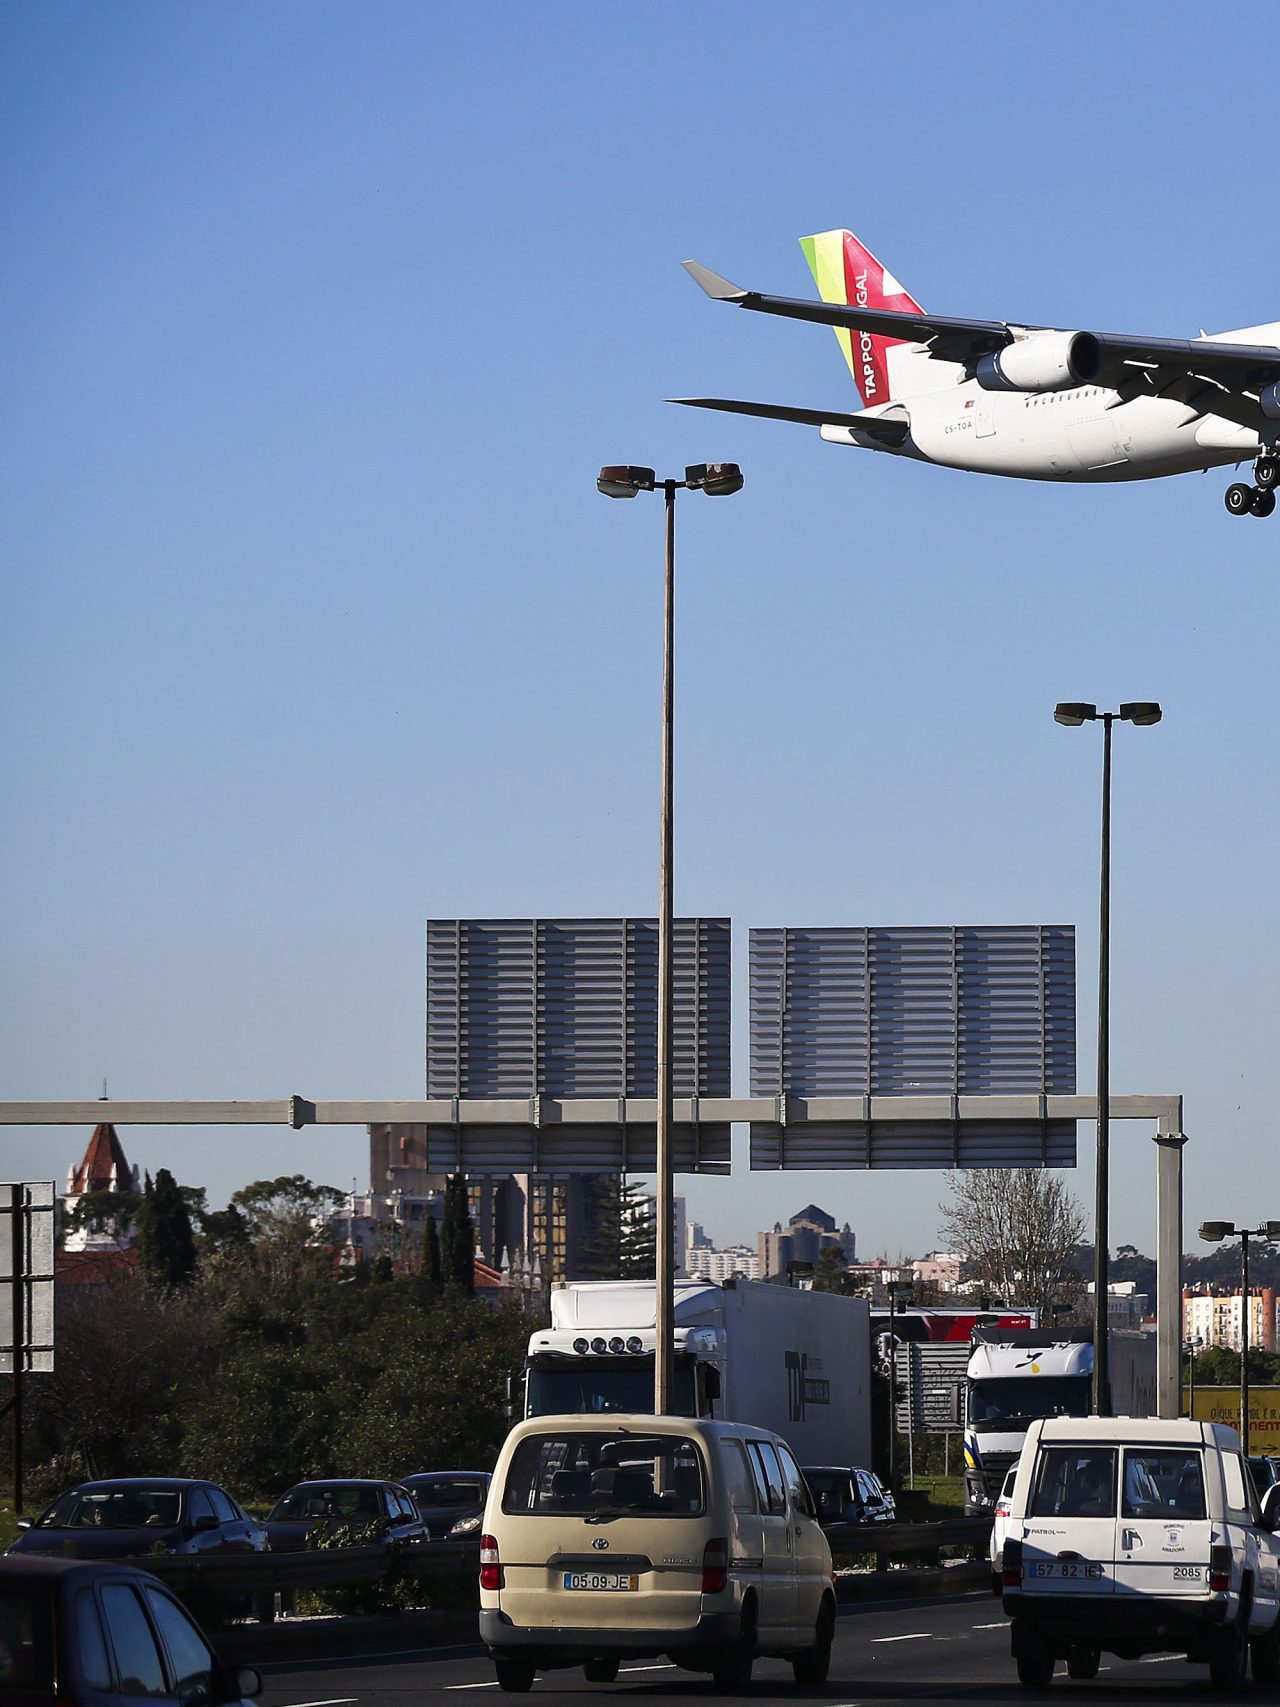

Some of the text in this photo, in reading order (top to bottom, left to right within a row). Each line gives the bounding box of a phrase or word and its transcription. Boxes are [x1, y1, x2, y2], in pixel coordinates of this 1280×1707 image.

[856, 269, 877, 399] TAP PORGAL
[945, 421, 971, 434] CS-TOA
[1210, 1408, 1216, 1419] O
[1219, 1408, 1233, 1420] QUE
[1237, 1408, 1261, 1420] RNDE
[1031, 1528, 1056, 1536] PATROL
[1174, 1567, 1201, 1577] 2085
